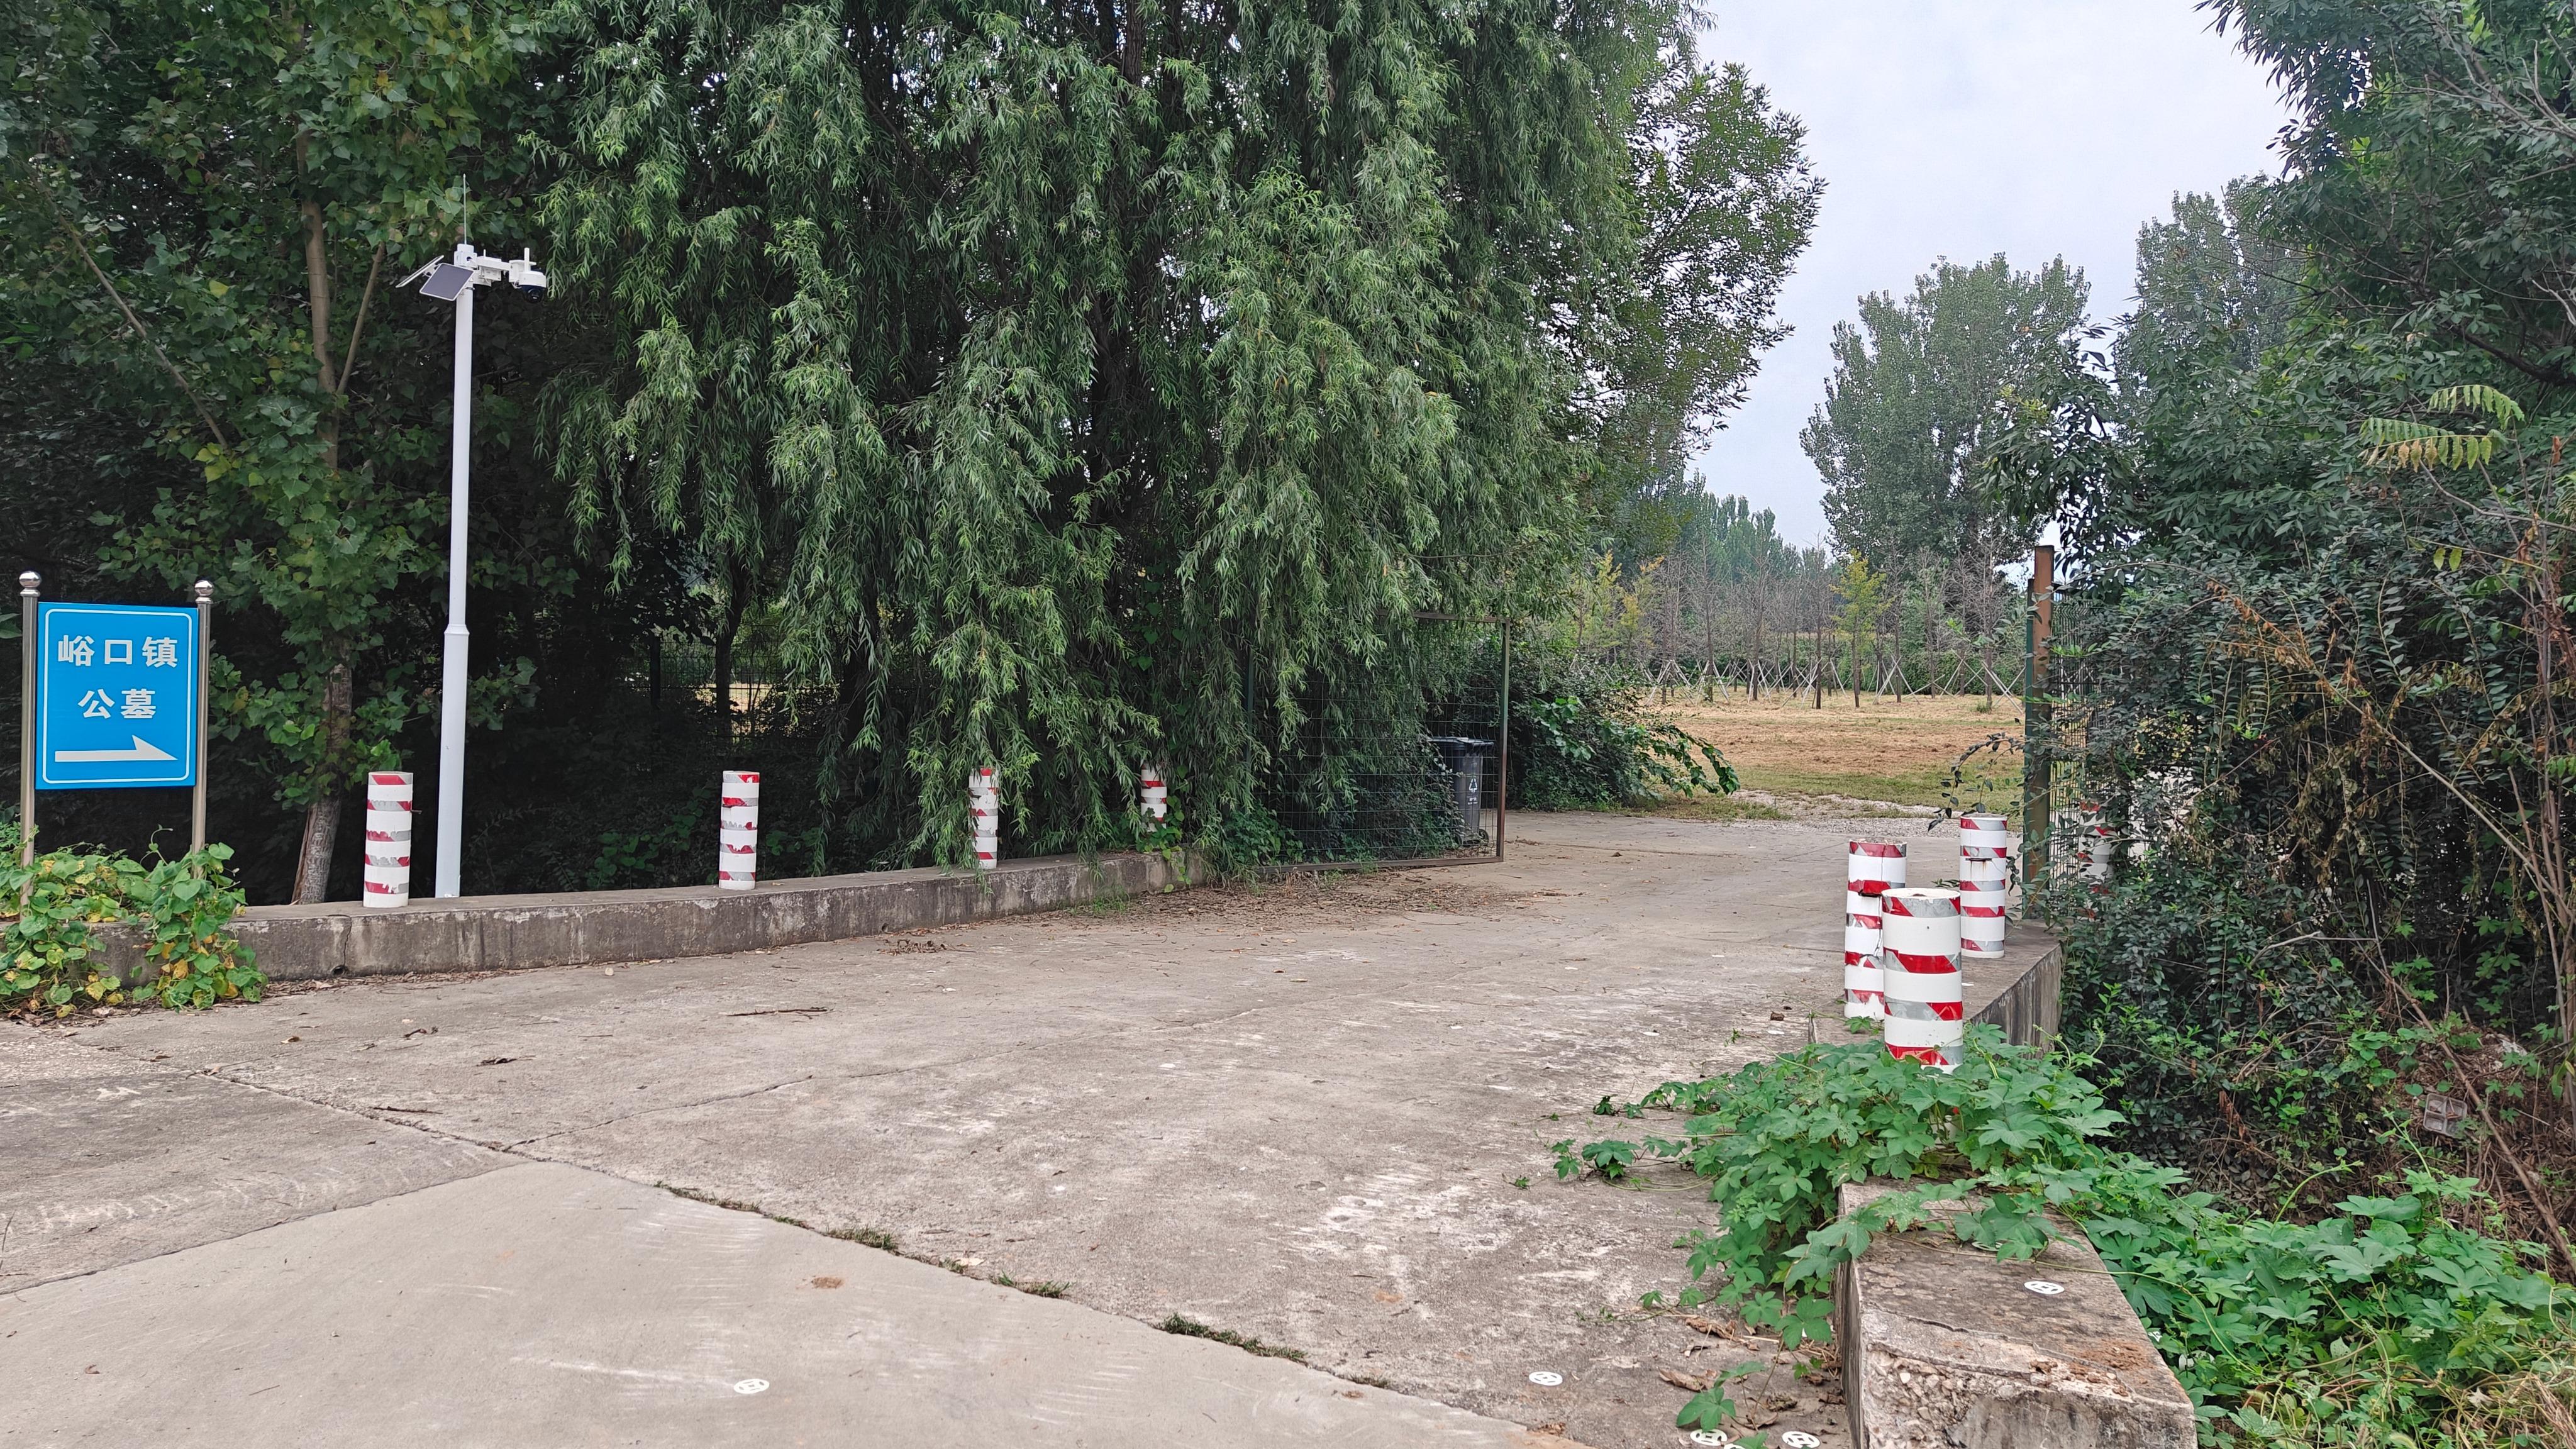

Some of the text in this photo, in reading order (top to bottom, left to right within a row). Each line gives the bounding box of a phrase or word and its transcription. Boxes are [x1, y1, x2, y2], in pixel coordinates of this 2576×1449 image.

[58, 635, 178, 668] 峪口镇
[78, 689, 156, 719] 公墓
